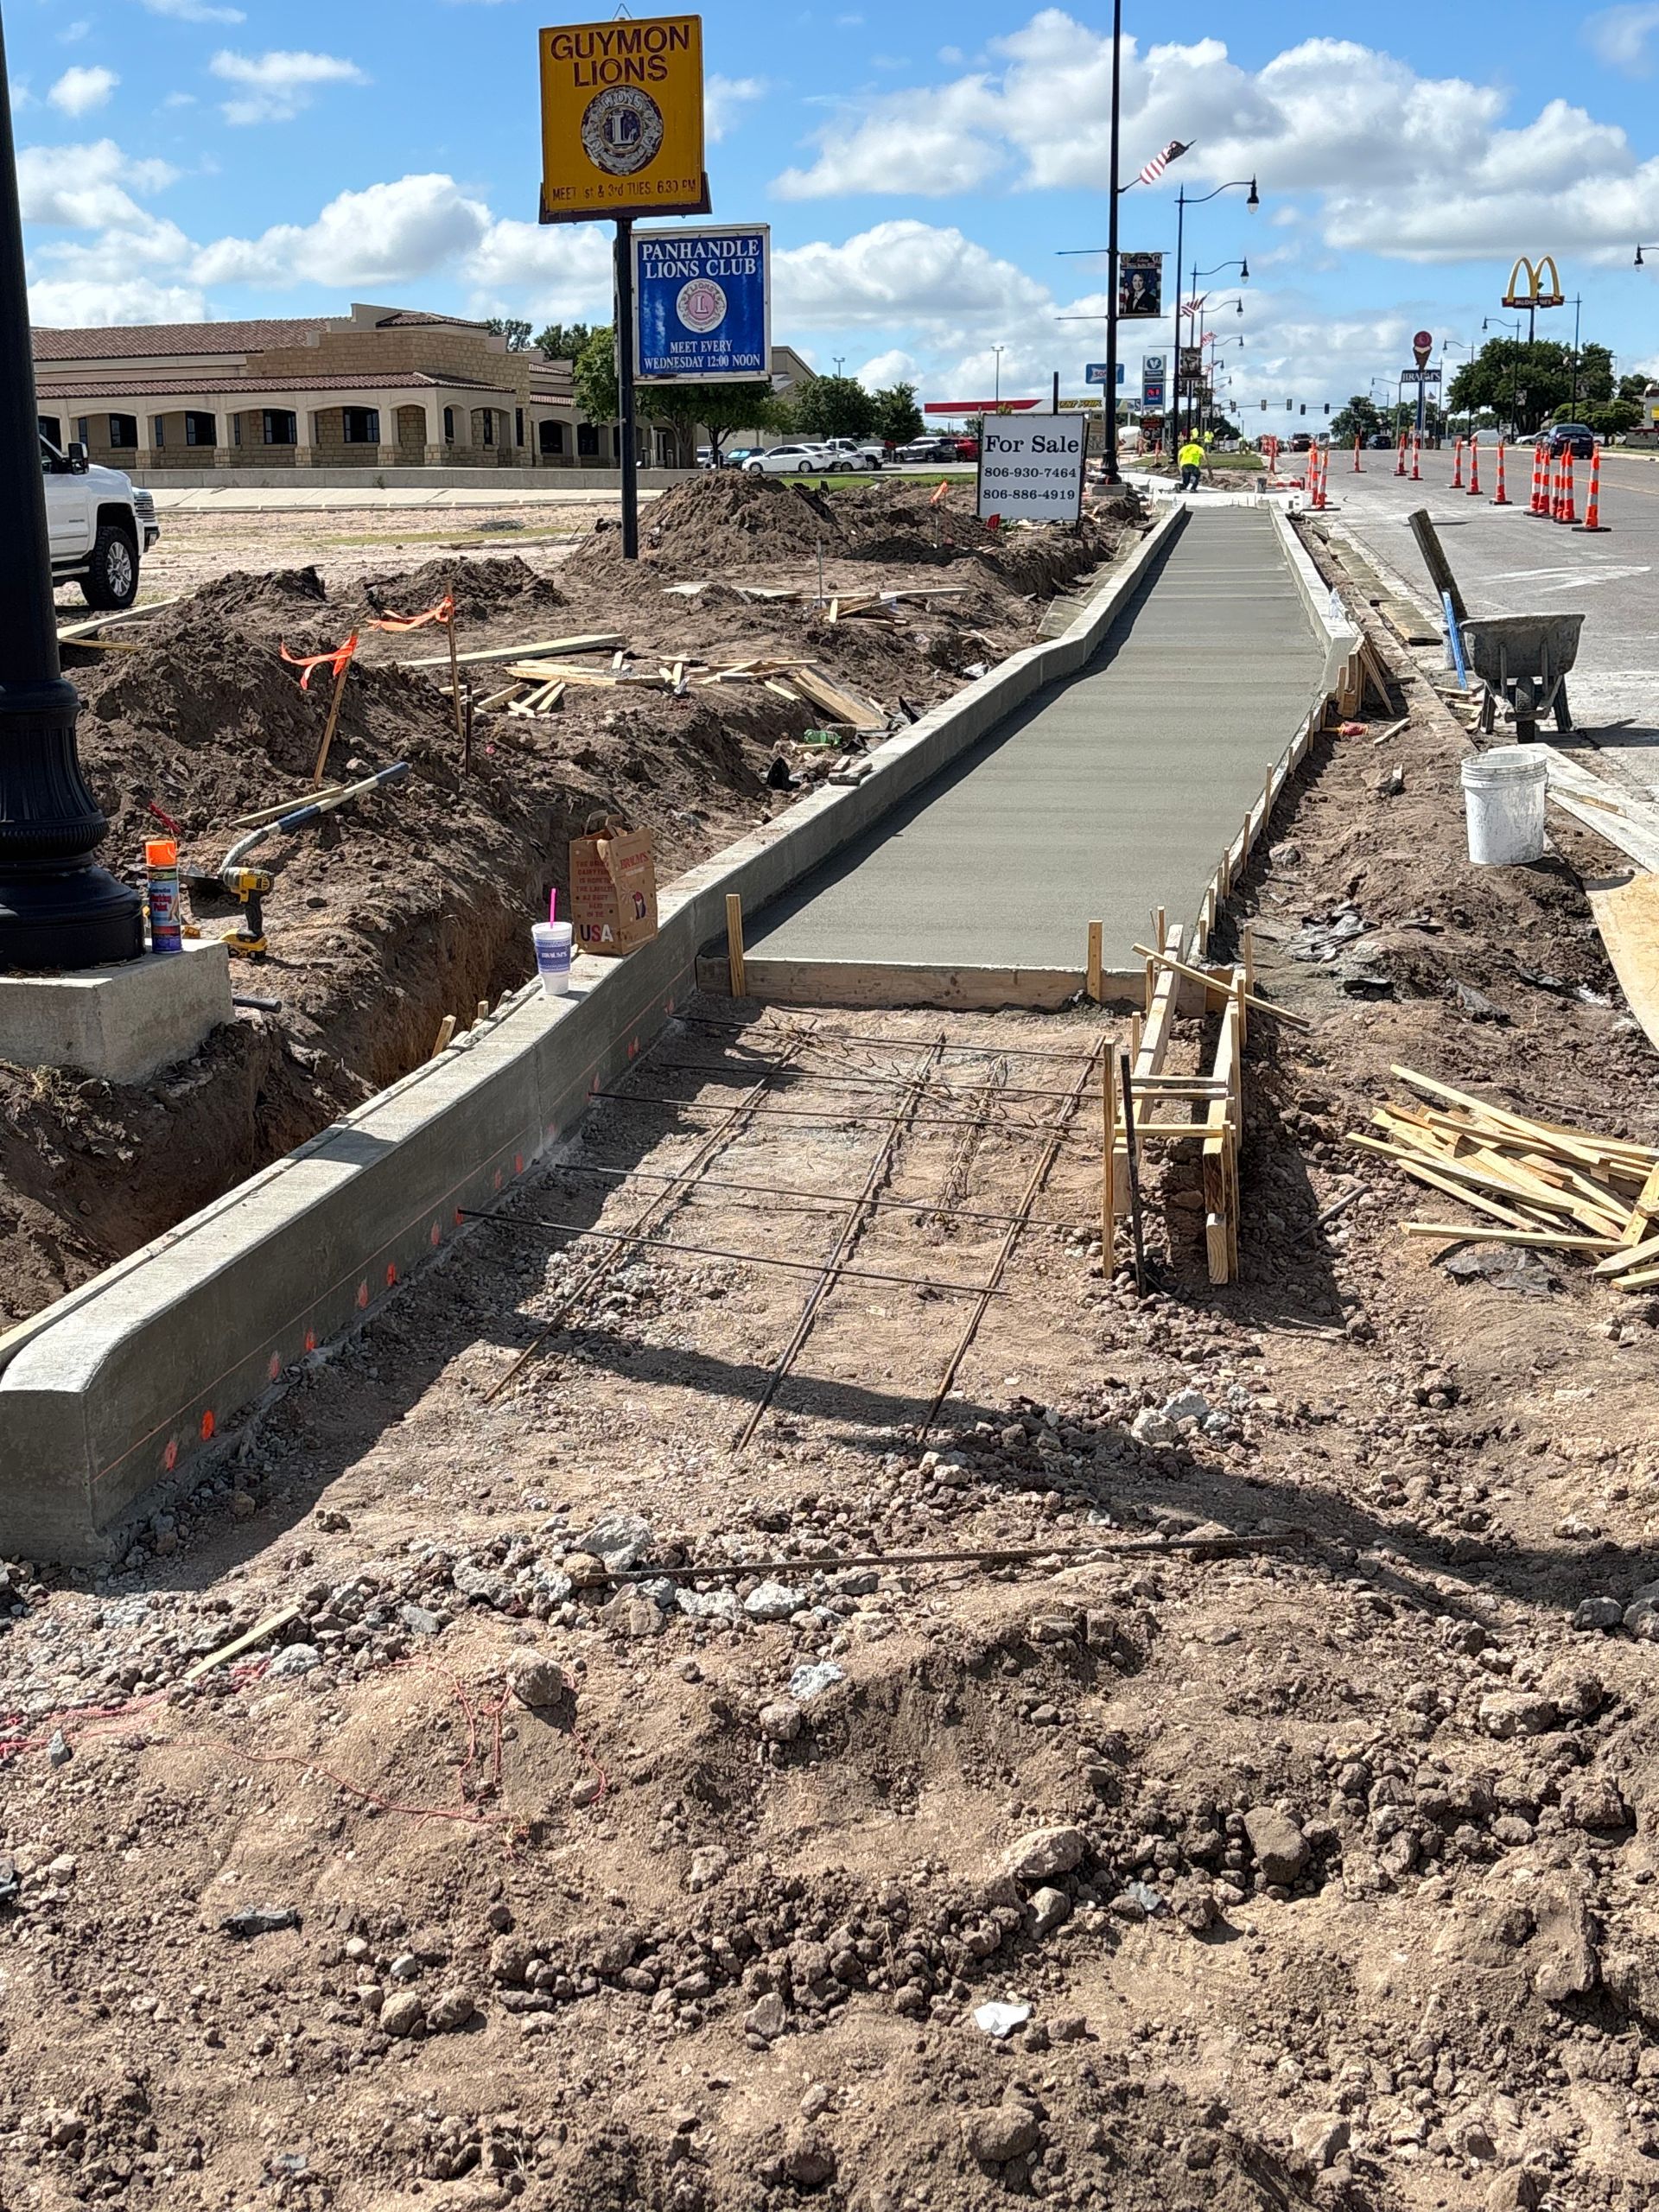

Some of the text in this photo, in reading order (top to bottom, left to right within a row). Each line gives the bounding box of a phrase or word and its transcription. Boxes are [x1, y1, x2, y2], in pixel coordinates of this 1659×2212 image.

[550, 24, 690, 61] GUYMON
[574, 54, 668, 87] LIONS
[553, 187, 576, 201] MEET
[597, 184, 605, 199] &
[608, 184, 624, 197] 3rd
[682, 179, 696, 192] PM
[642, 239, 760, 261] PANHANDLE
[645, 258, 756, 279] LIONS CLUB
[670, 340, 733, 354] MEET EVERY
[644, 353, 760, 369] WEDNESDAY 12:00 NOON
[984, 435, 1024, 453] For
[1031, 435, 1079, 454] Sale
[984, 467, 1077, 478] 806-930-7464
[982, 489, 1075, 500] 806-886-4919
[580, 924, 613, 943] USA
